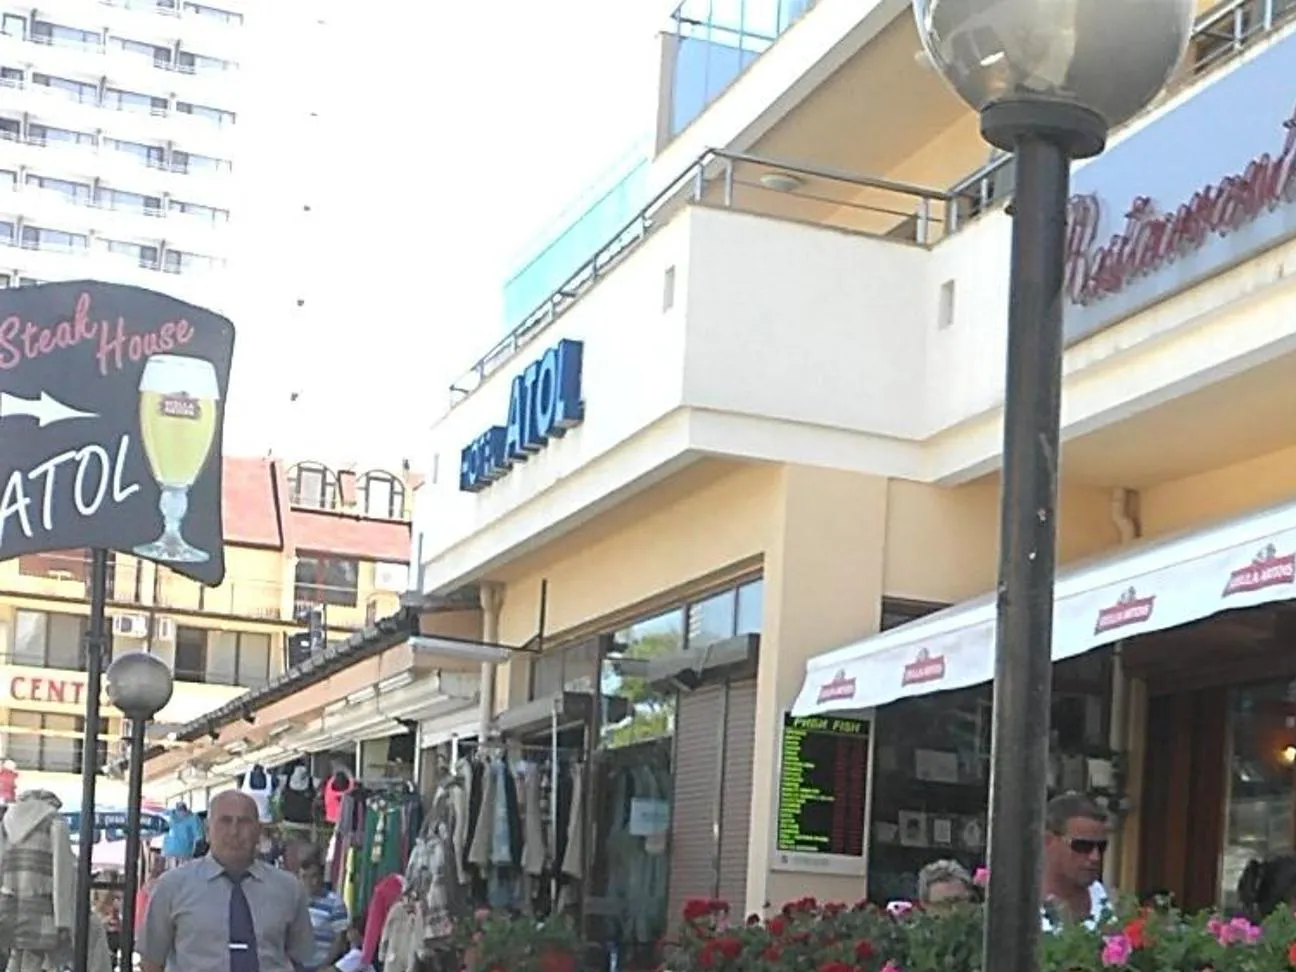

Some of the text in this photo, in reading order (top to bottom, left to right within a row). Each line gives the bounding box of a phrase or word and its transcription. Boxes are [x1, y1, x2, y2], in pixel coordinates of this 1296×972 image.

[0, 292, 195, 376] Steak House
[0, 434, 140, 547] ATOL
[10, 676, 113, 706] CENT
